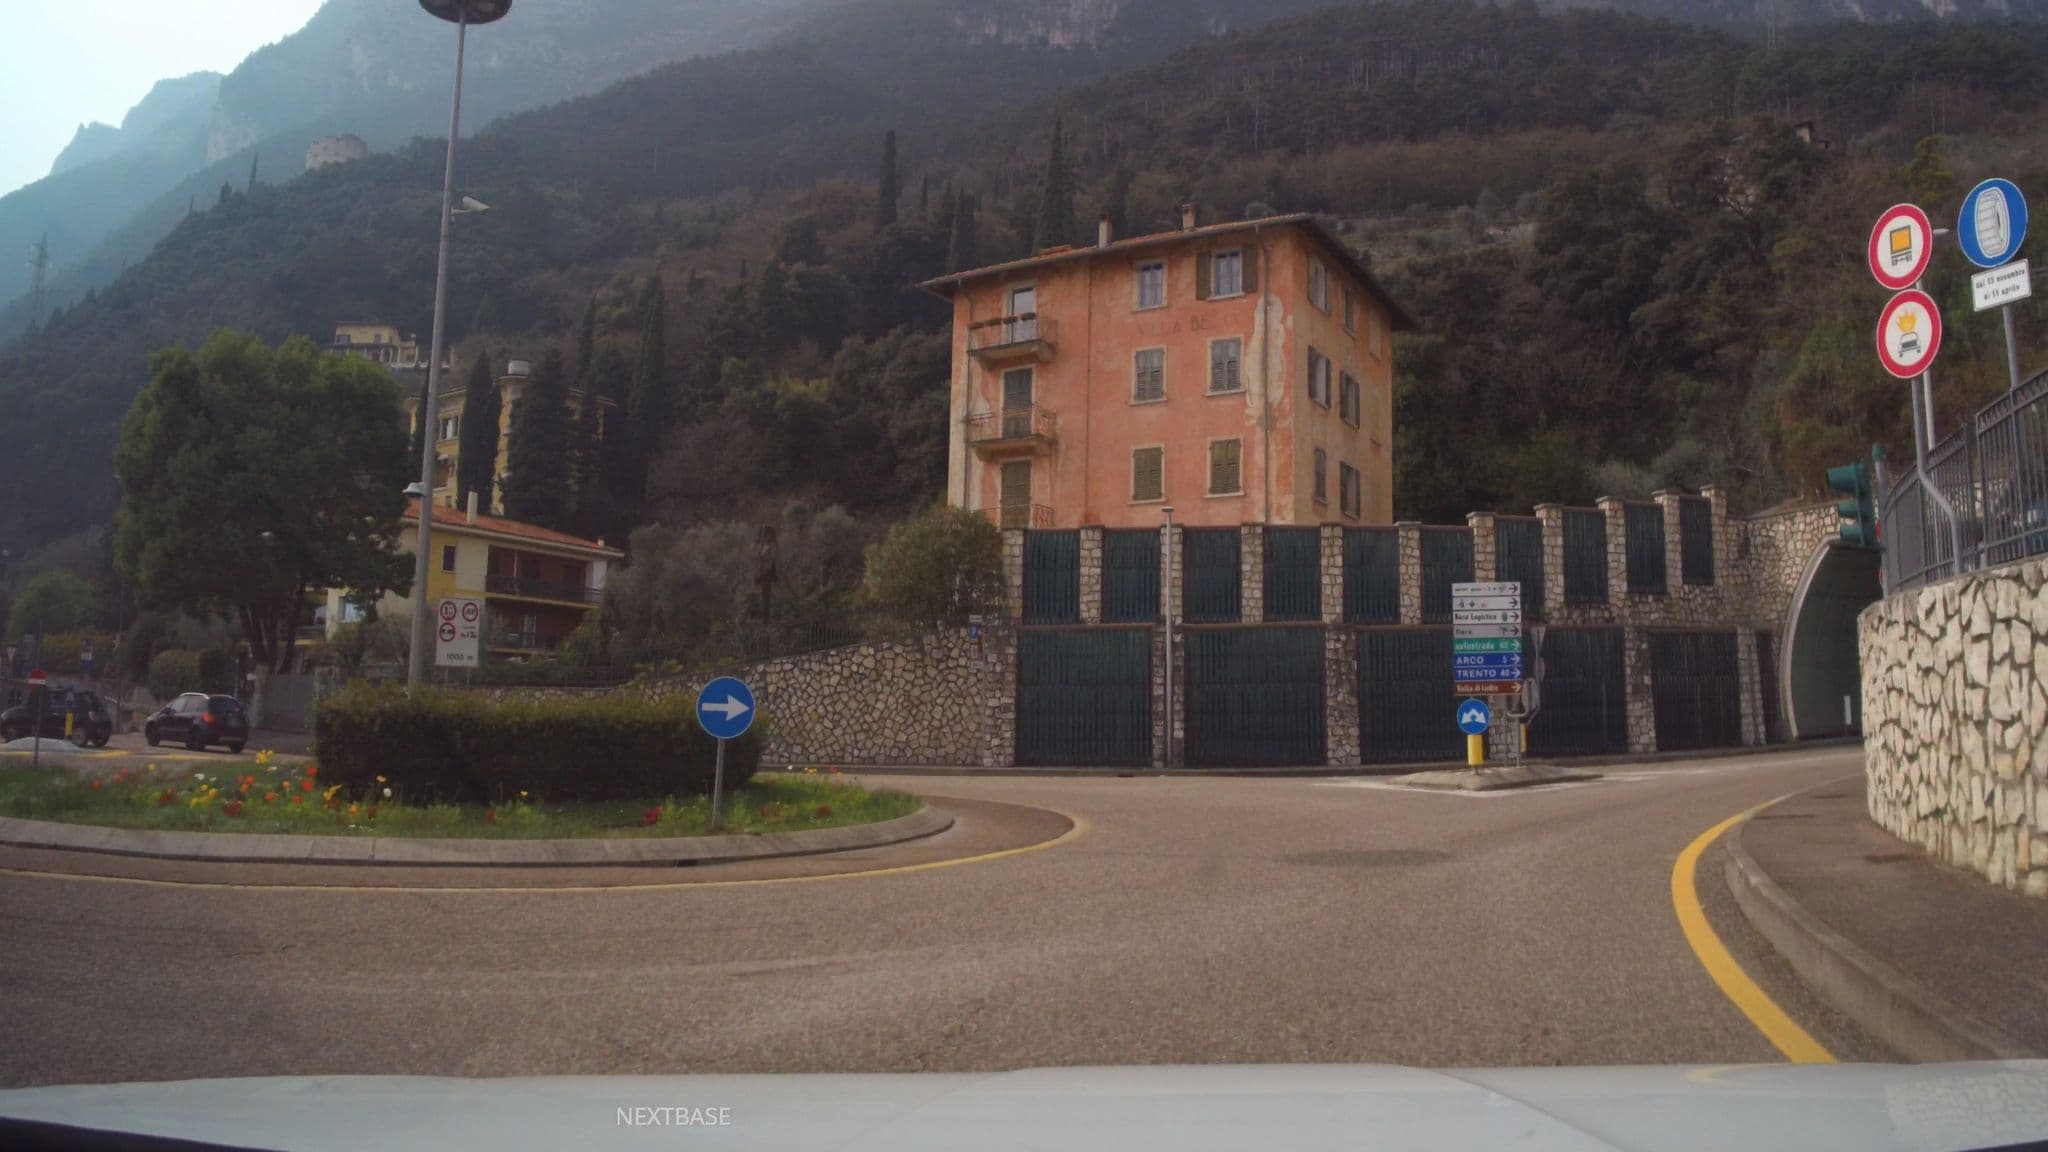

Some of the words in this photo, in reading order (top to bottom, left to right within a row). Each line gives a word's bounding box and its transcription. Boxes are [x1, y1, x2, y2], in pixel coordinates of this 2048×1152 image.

[1456, 641, 1494, 649] autostrada
[1456, 656, 1484, 665] ARCO
[1456, 669, 1497, 678] TRENTO
